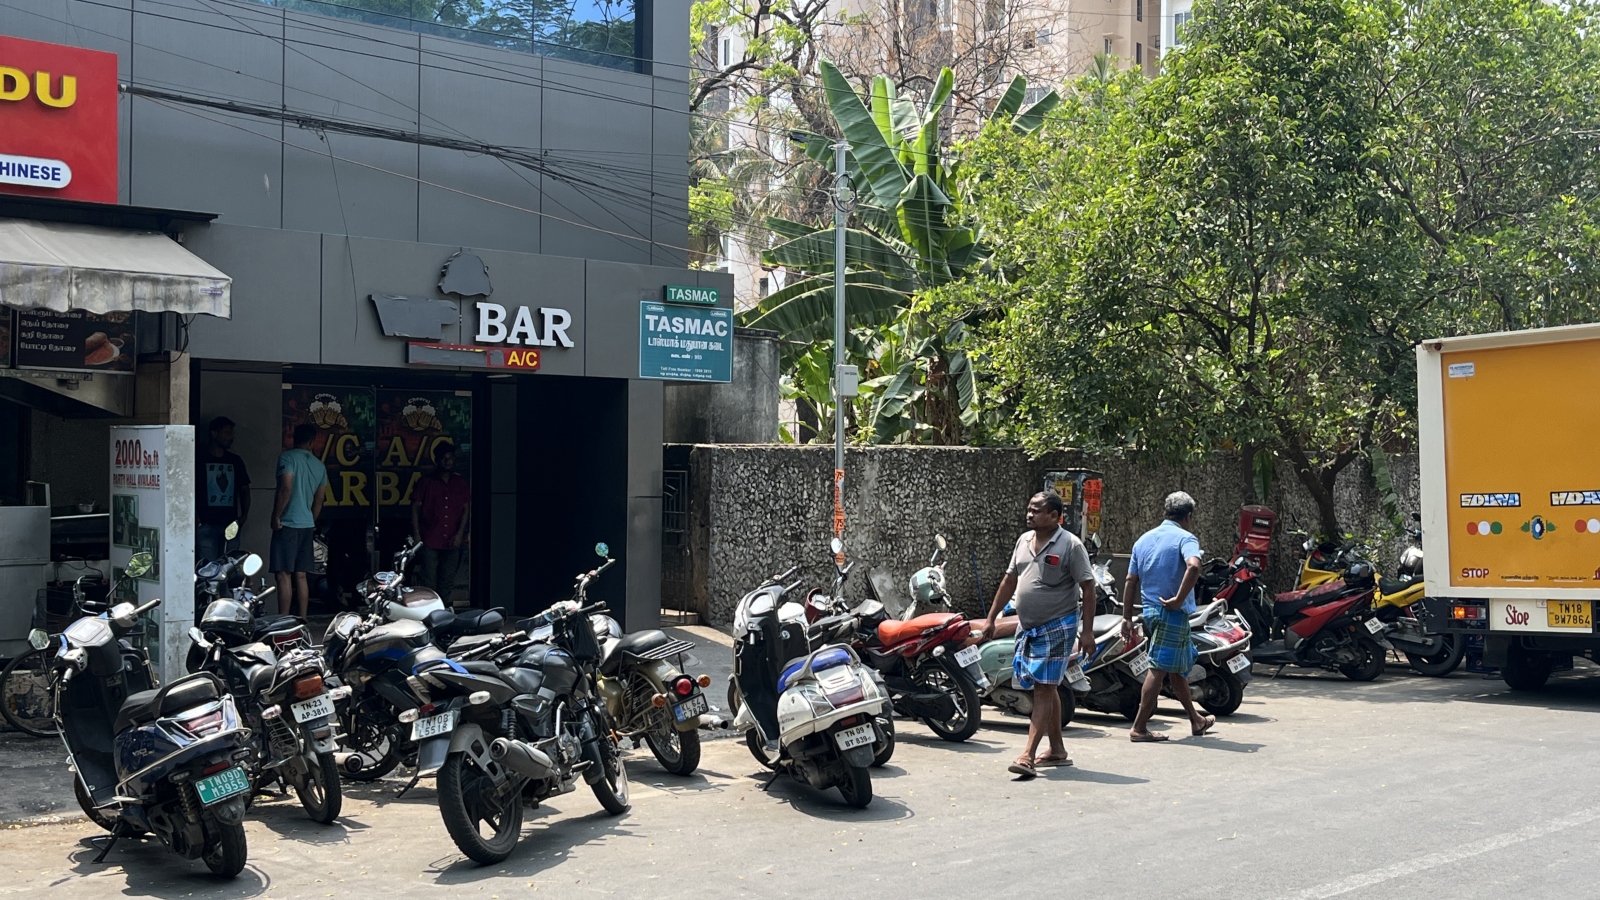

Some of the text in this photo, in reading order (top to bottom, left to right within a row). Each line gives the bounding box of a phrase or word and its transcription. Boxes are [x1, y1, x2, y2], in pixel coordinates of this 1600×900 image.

[0, 65, 77, 108] DU
[0, 161, 61, 181] HINESE
[669, 288, 717, 302] TASMAC
[475, 302, 574, 348] BAR
[645, 314, 728, 337] TASMAC
[507, 351, 538, 367] A/C
[115, 439, 141, 466] 2000
[1552, 491, 1600, 505] HOR
[1462, 568, 1489, 578] STOP
[1506, 604, 1529, 626] Stop
[1559, 604, 1582, 614] TN18
[1555, 614, 1590, 624] BW7864
[301, 699, 322, 710] TN-23
[302, 706, 328, 720] AP-3811
[844, 730, 855, 738] TN
[845, 739, 855, 747] BT
[207, 770, 240, 788] TN09D
[211, 778, 244, 798] M3955
